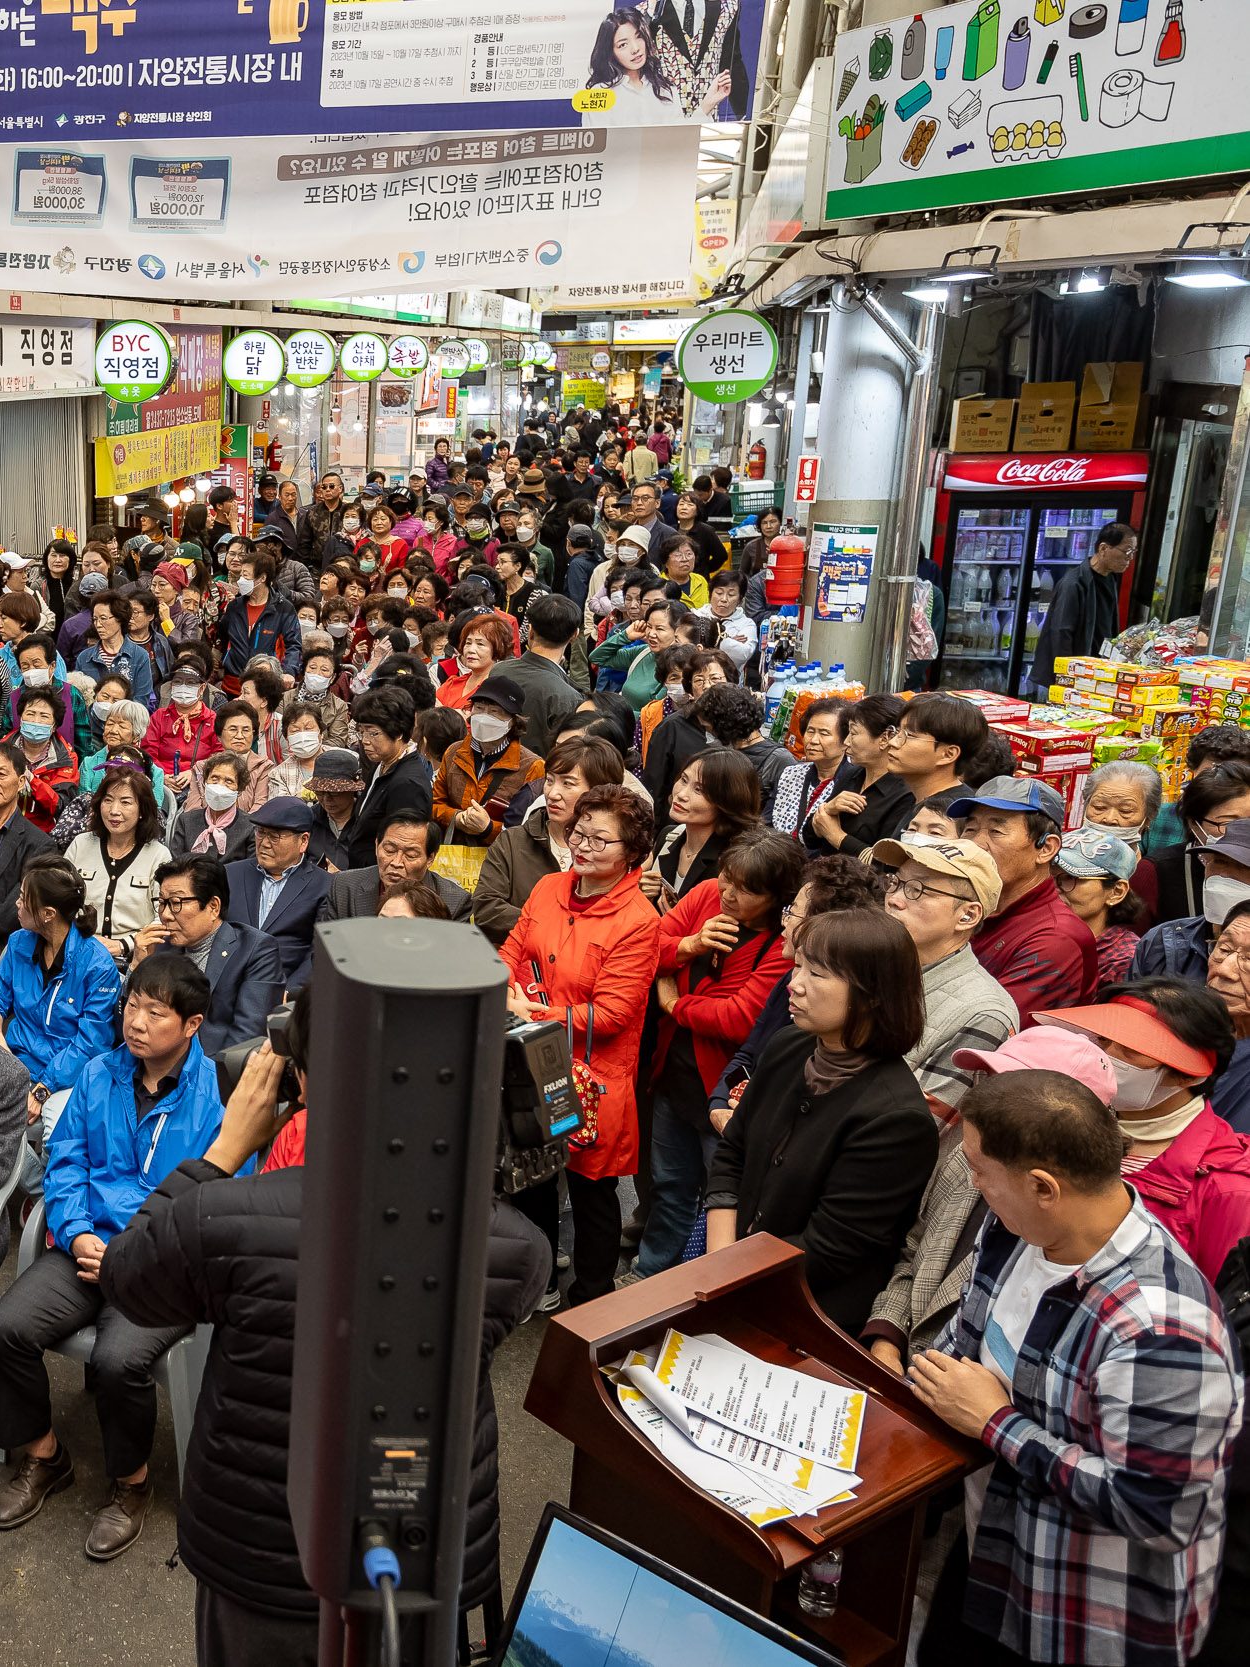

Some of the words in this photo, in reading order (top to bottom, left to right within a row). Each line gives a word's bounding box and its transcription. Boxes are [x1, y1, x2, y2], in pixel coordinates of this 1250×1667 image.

[474, 33, 504, 44] 경품안내
[20, 64, 124, 90] 16:00~20:00
[138, 53, 276, 87] 자양전통시장
[280, 52, 302, 82] 내
[581, 100, 606, 109] 노현지
[73, 114, 106, 125] 광진구
[134, 112, 184, 124] 자양전통시장
[186, 111, 212, 122] 상인회
[702, 240, 725, 248] OPEN
[568, 286, 620, 297] 자양전통시장
[621, 284, 647, 294] 질서를
[649, 280, 686, 292] 해칩니다
[20, 327, 74, 368] 직영점
[112, 334, 150, 352] BYC
[243, 340, 266, 354] 하림
[290, 340, 324, 355] 맛있는
[352, 340, 376, 354] 신선
[692, 331, 764, 352] 우리마트
[295, 356, 318, 370] 반찬
[352, 354, 375, 367] 야채
[391, 346, 422, 366] 족발
[104, 356, 159, 379] 직영점
[246, 357, 262, 376] 닭
[709, 354, 745, 375] 생선
[714, 383, 736, 396] 생선
[996, 458, 1092, 482] Coca-Cola
